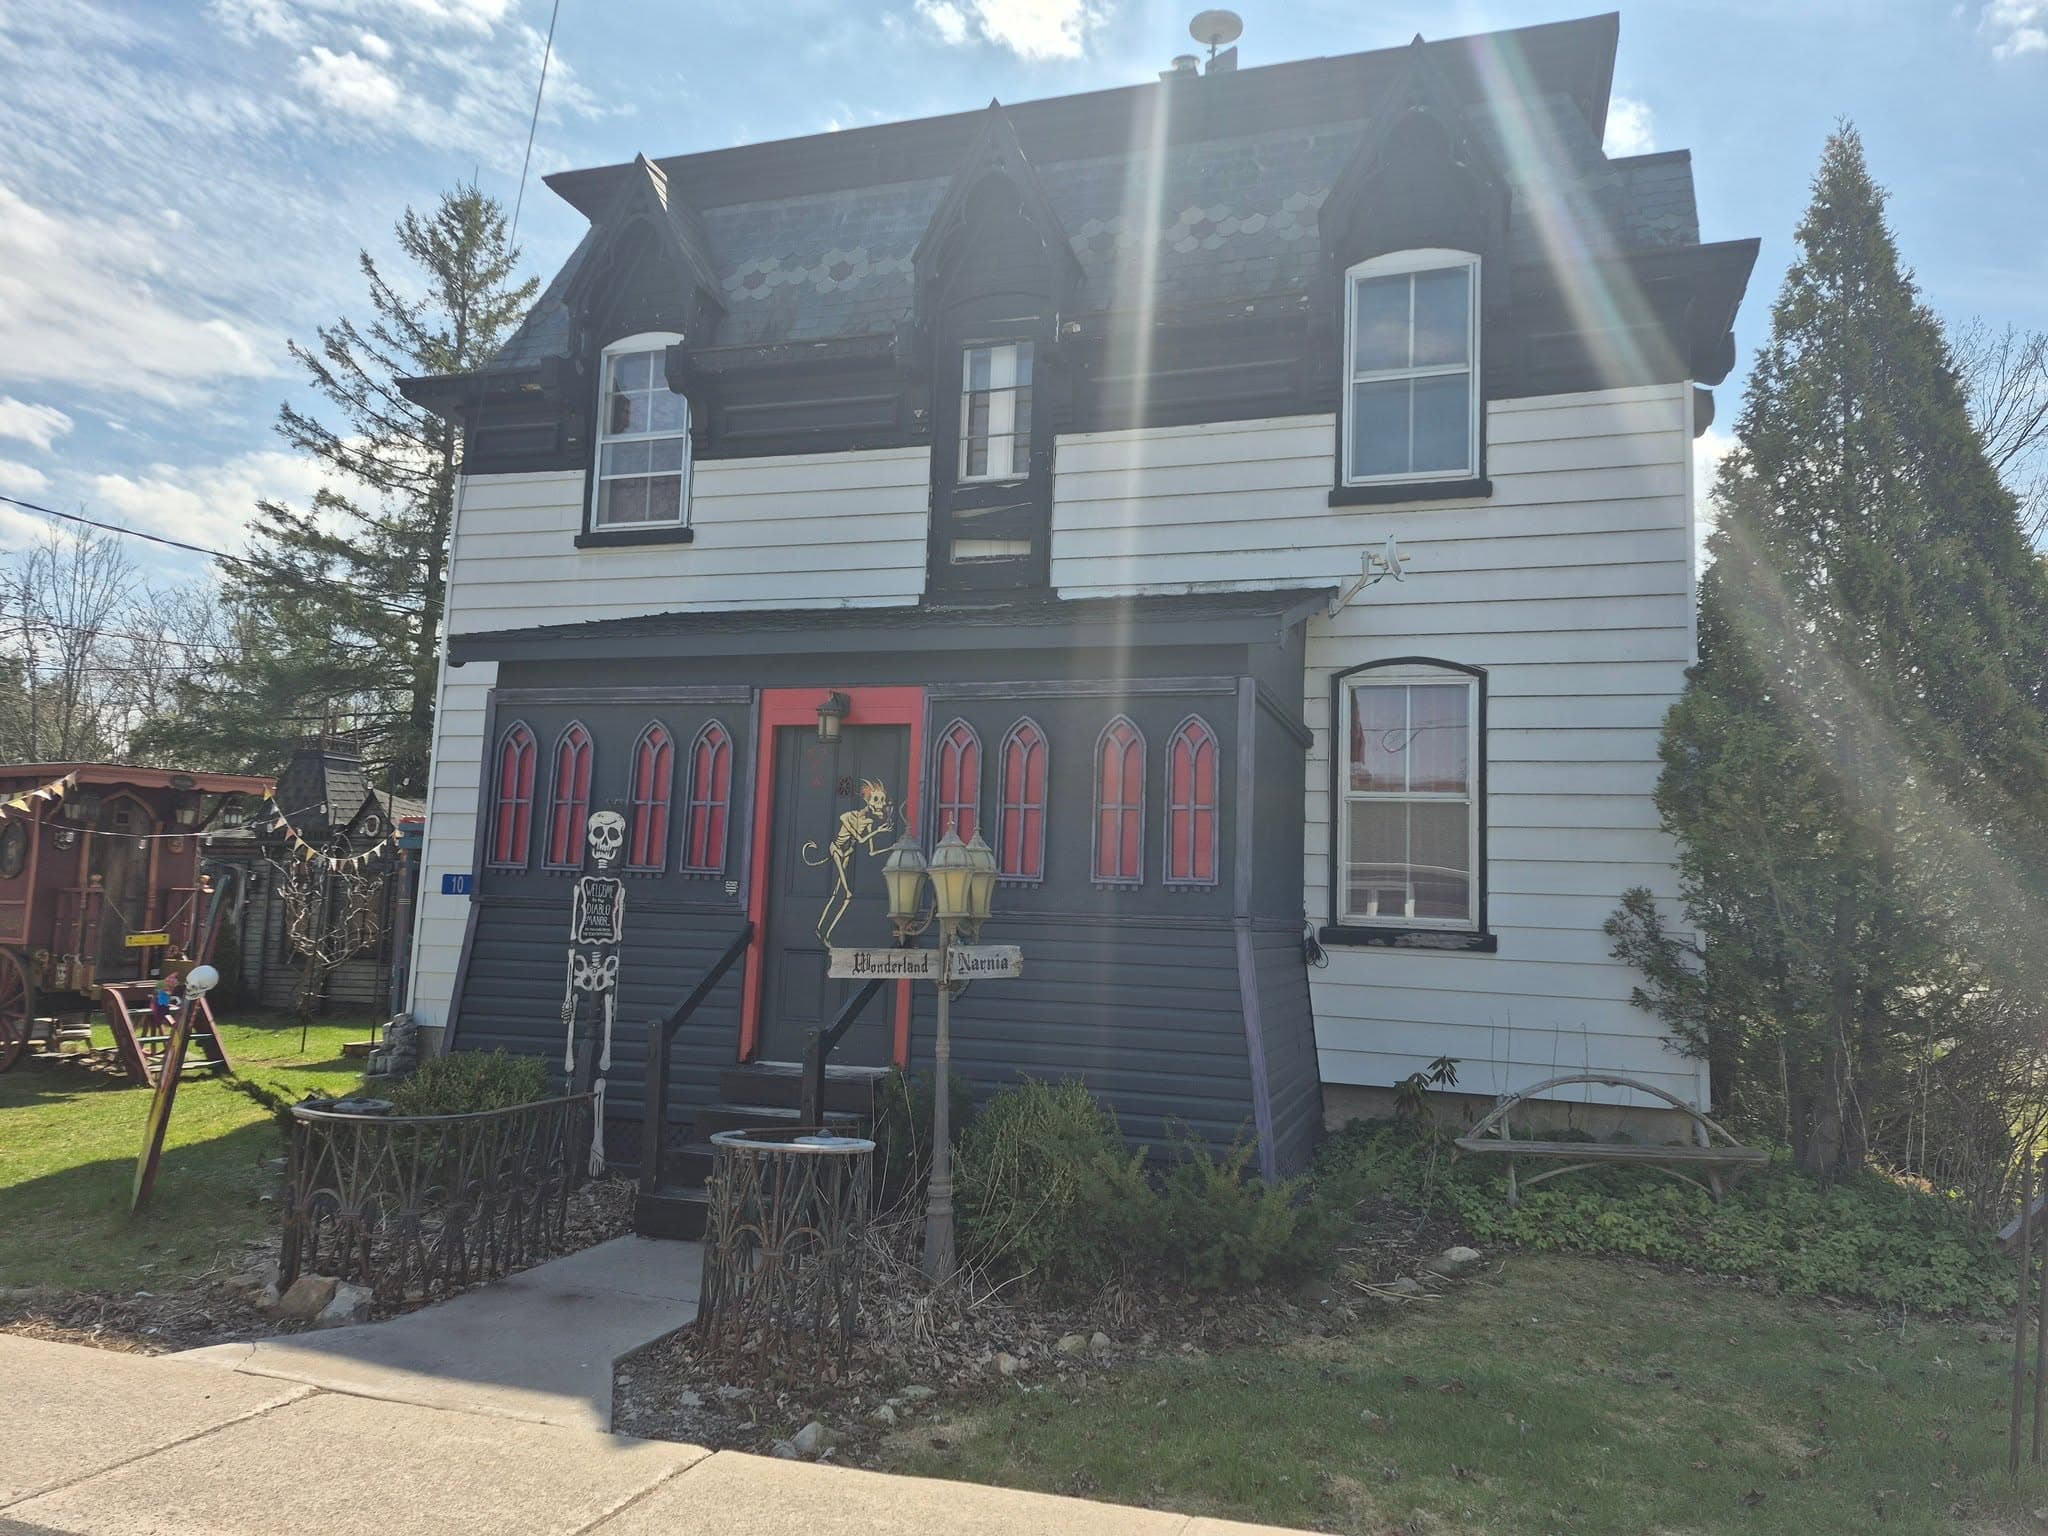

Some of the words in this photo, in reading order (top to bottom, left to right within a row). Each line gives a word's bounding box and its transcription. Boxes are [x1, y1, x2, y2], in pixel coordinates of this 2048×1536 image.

[452, 876, 464, 893] 10
[585, 882, 615, 898] WELCOME
[586, 902, 611, 916] DIABLO
[852, 952, 929, 975] Wonderland
[958, 952, 1009, 975] Narnia
